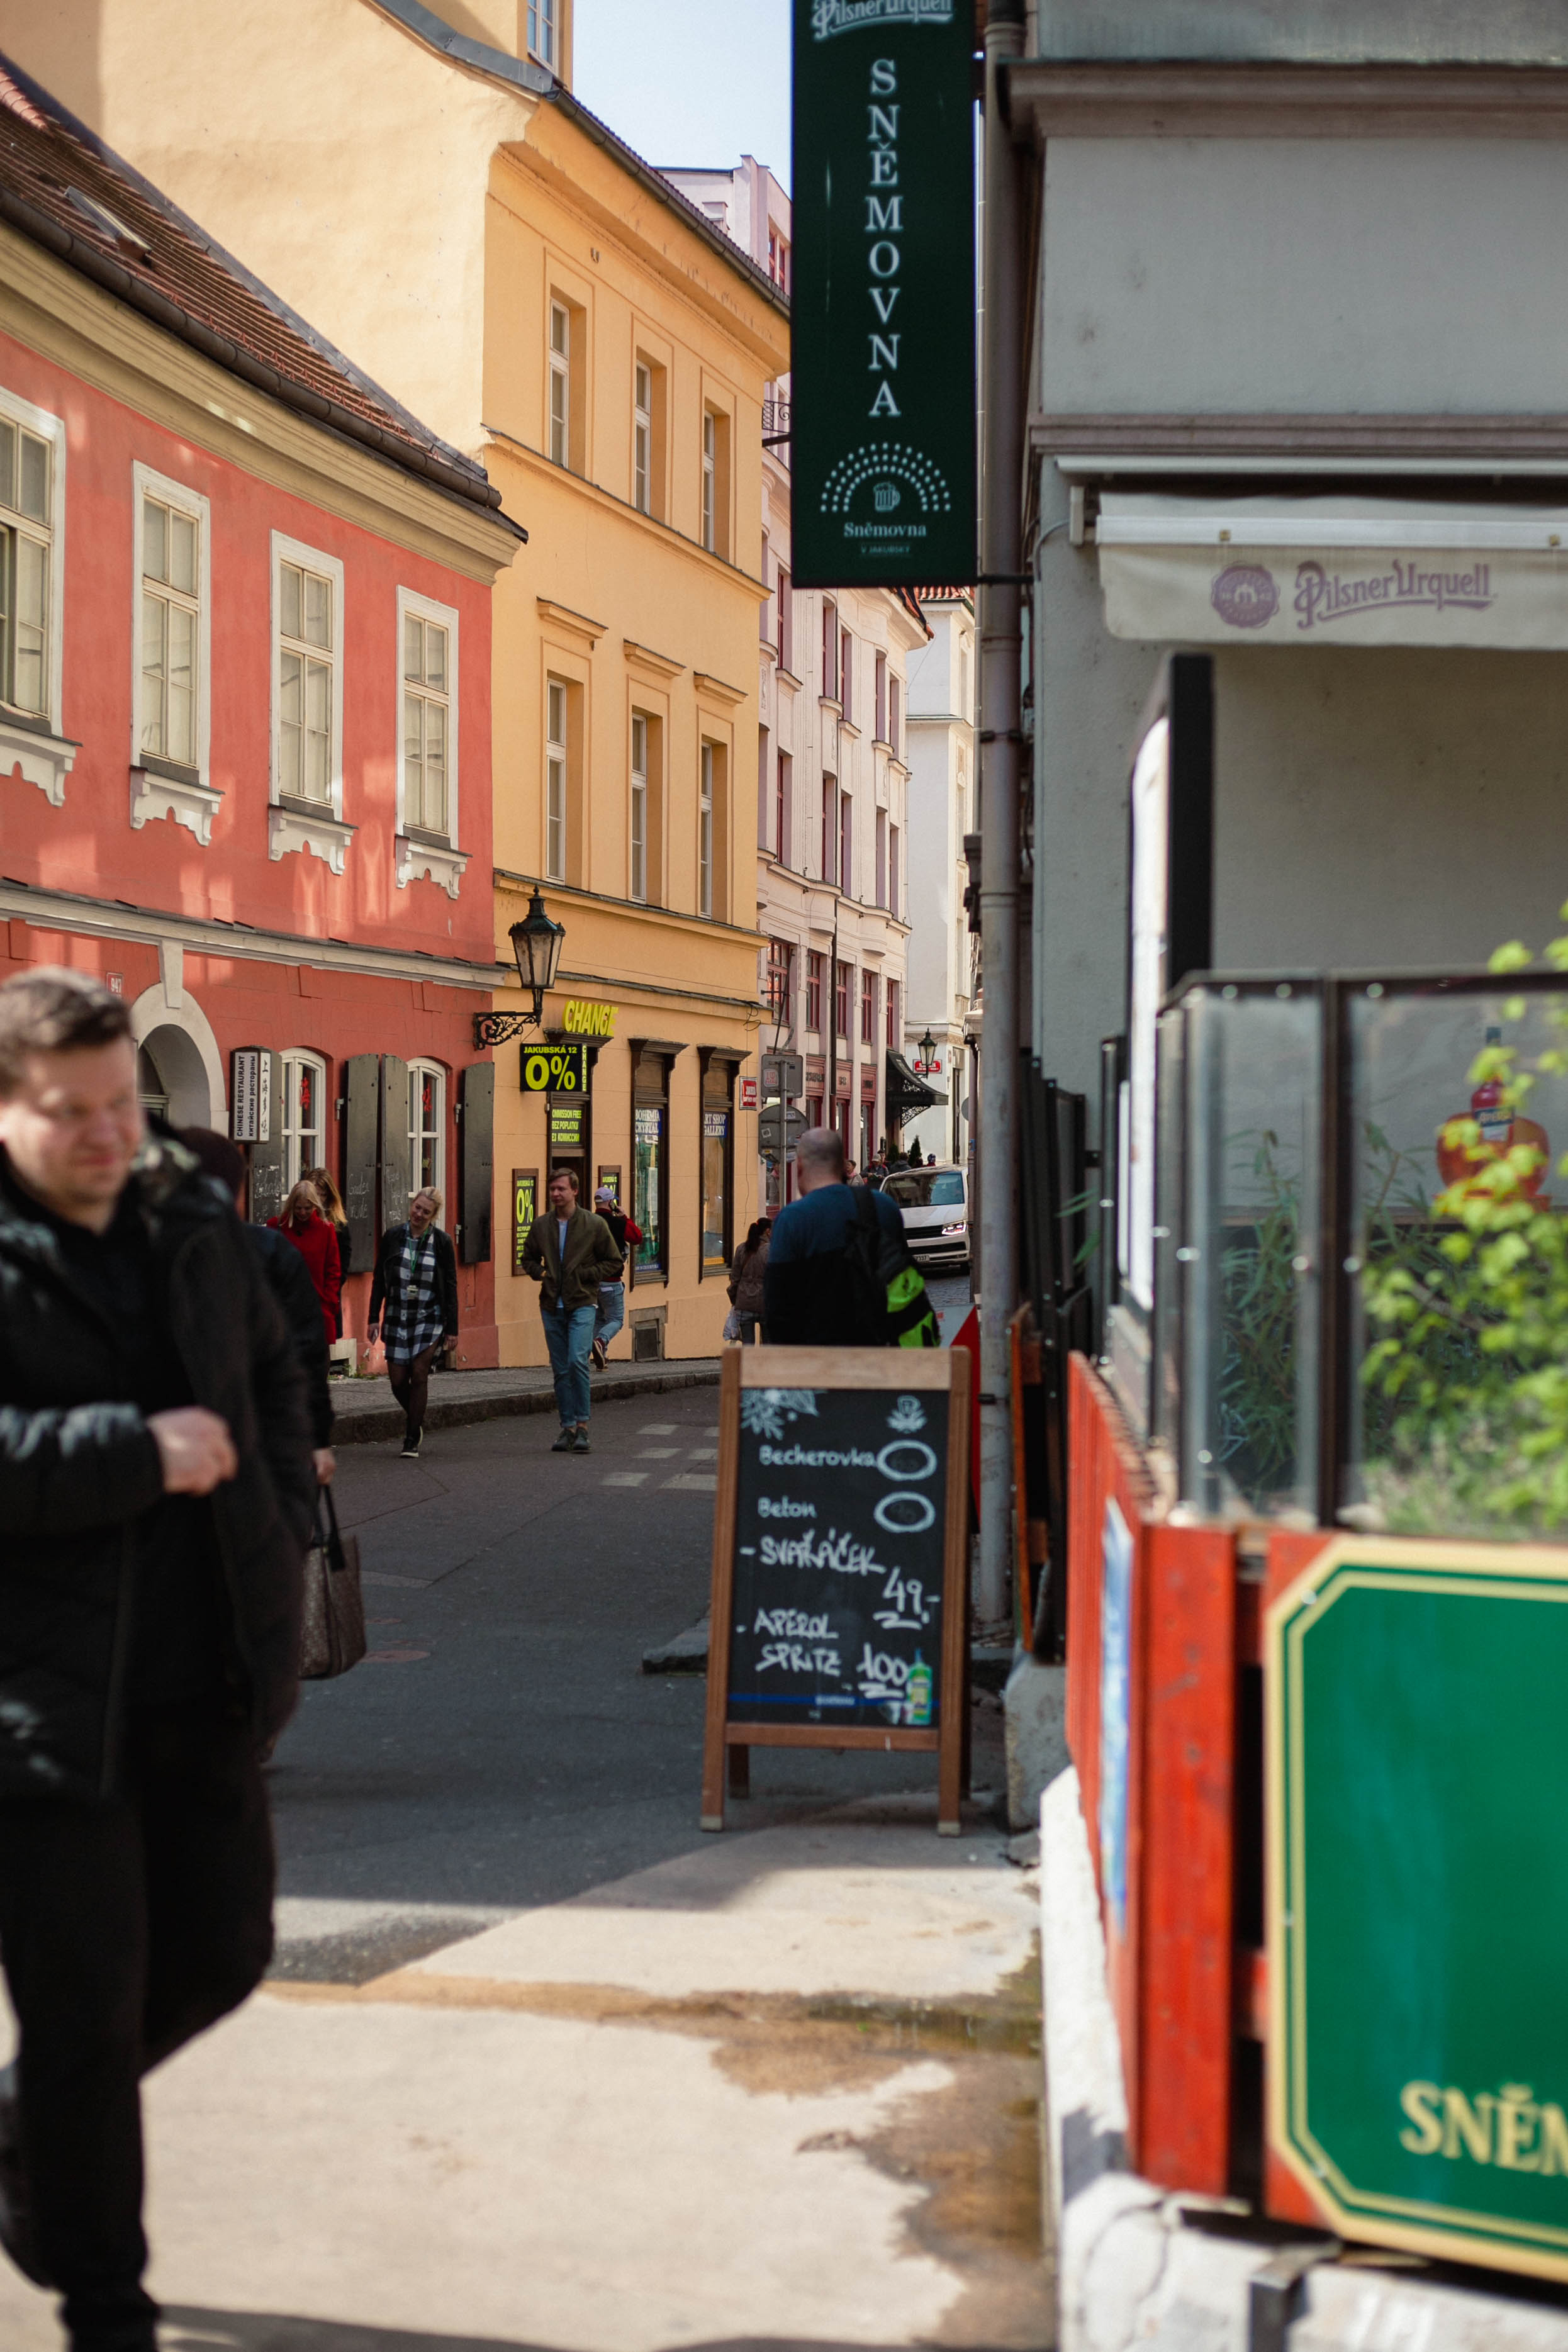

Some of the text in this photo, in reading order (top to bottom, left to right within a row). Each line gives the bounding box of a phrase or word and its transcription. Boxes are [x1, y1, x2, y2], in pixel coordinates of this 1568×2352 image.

[865, 59, 904, 417] SNĚMOVNA
[843, 522, 927, 537] Sněmovna
[1294, 560, 1395, 630] Pilsner
[1392, 559, 1491, 611] Urquell
[564, 1000, 619, 1037] CHANGE
[524, 1044, 566, 1054] JAKUBSKÁ
[237, 1055, 245, 1104] RESTAURANT
[525, 1055, 576, 1090] 0%
[713, 1114, 725, 1124] SHOP
[517, 1189, 534, 1224] 0%
[759, 1443, 878, 1467] Becherovka
[758, 1494, 818, 1518] Beton
[754, 1608, 839, 1640] APEROL
[755, 1642, 910, 1686] SPRITZ 100
